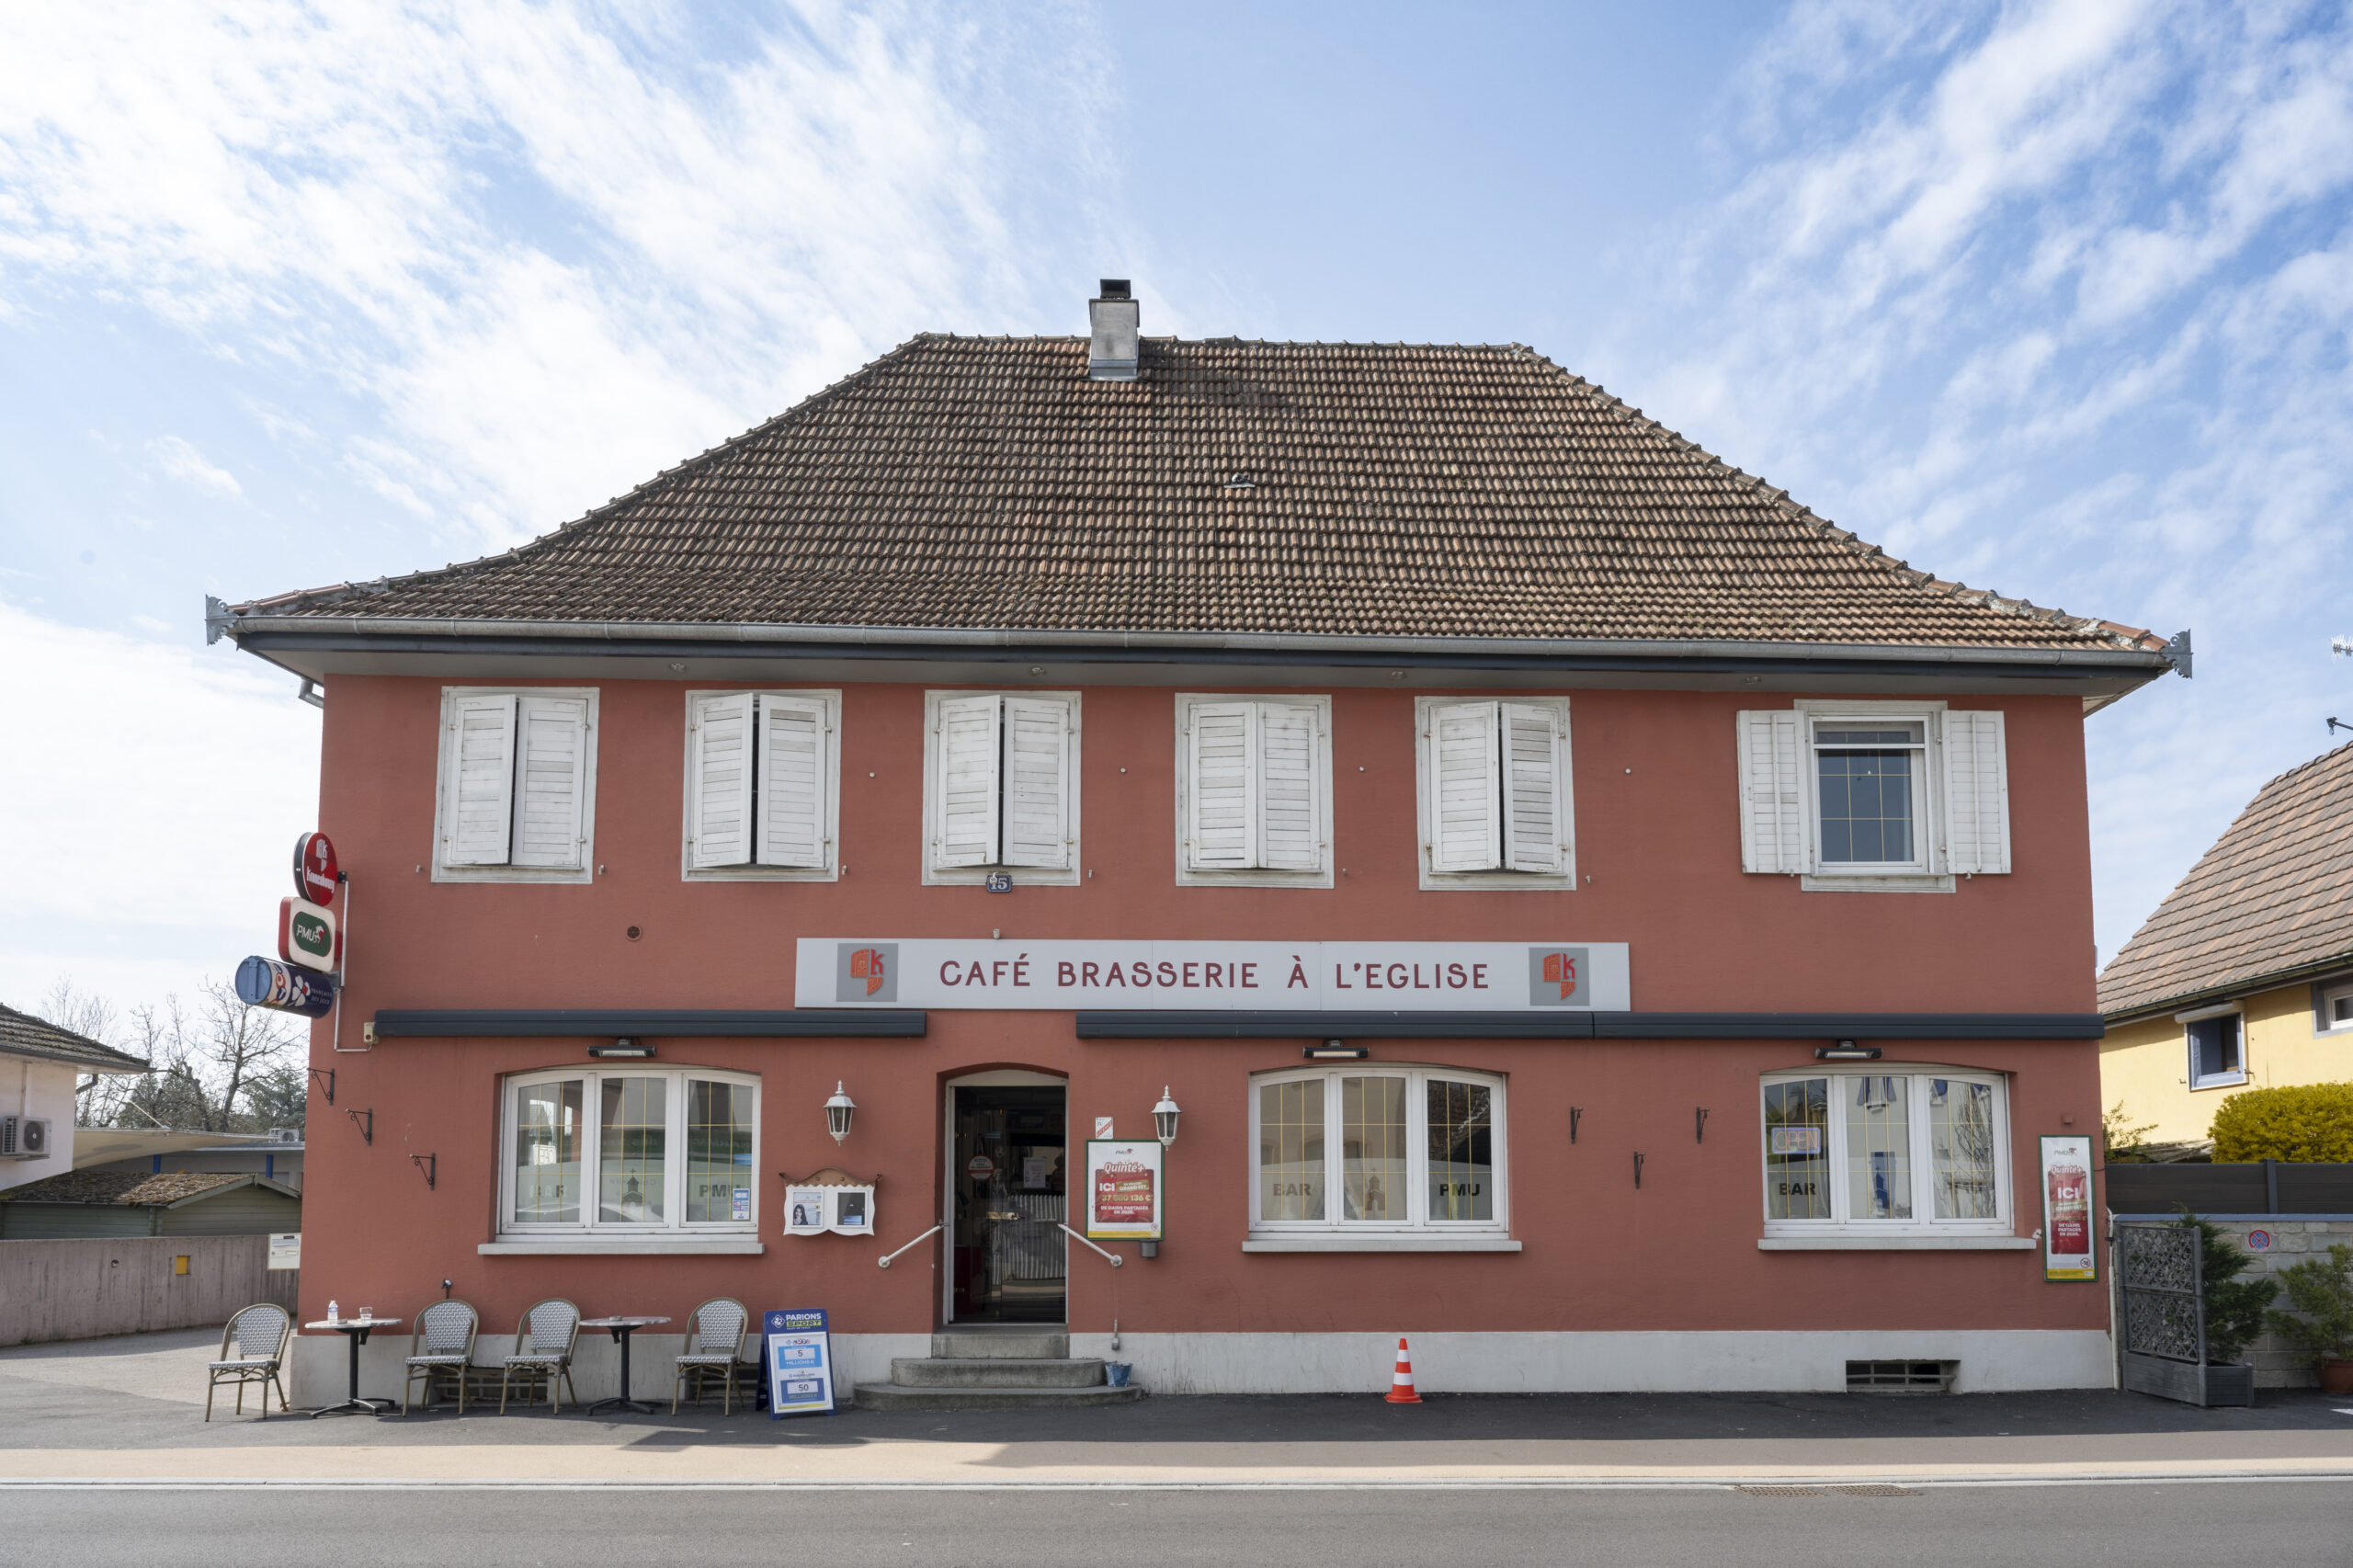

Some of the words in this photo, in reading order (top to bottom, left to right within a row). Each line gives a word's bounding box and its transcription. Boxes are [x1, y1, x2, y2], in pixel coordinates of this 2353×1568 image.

[296, 924, 314, 942] PMU
[939, 953, 1031, 987] CAFÉ
[1057, 960, 1259, 989] BRASSERIE
[1287, 955, 1309, 989] À
[1336, 962, 1489, 990] L'EGLISE
[1774, 1131, 1819, 1150] OPEN
[1104, 1162, 1144, 1173] Quinté+
[1098, 1183, 1115, 1191] ICI
[1273, 1183, 1311, 1197] BAR
[1439, 1183, 1480, 1197] PMU
[1779, 1182, 1816, 1195] BAR
[2057, 1187, 2079, 1199] ICI
[798, 1383, 809, 1392] 50
